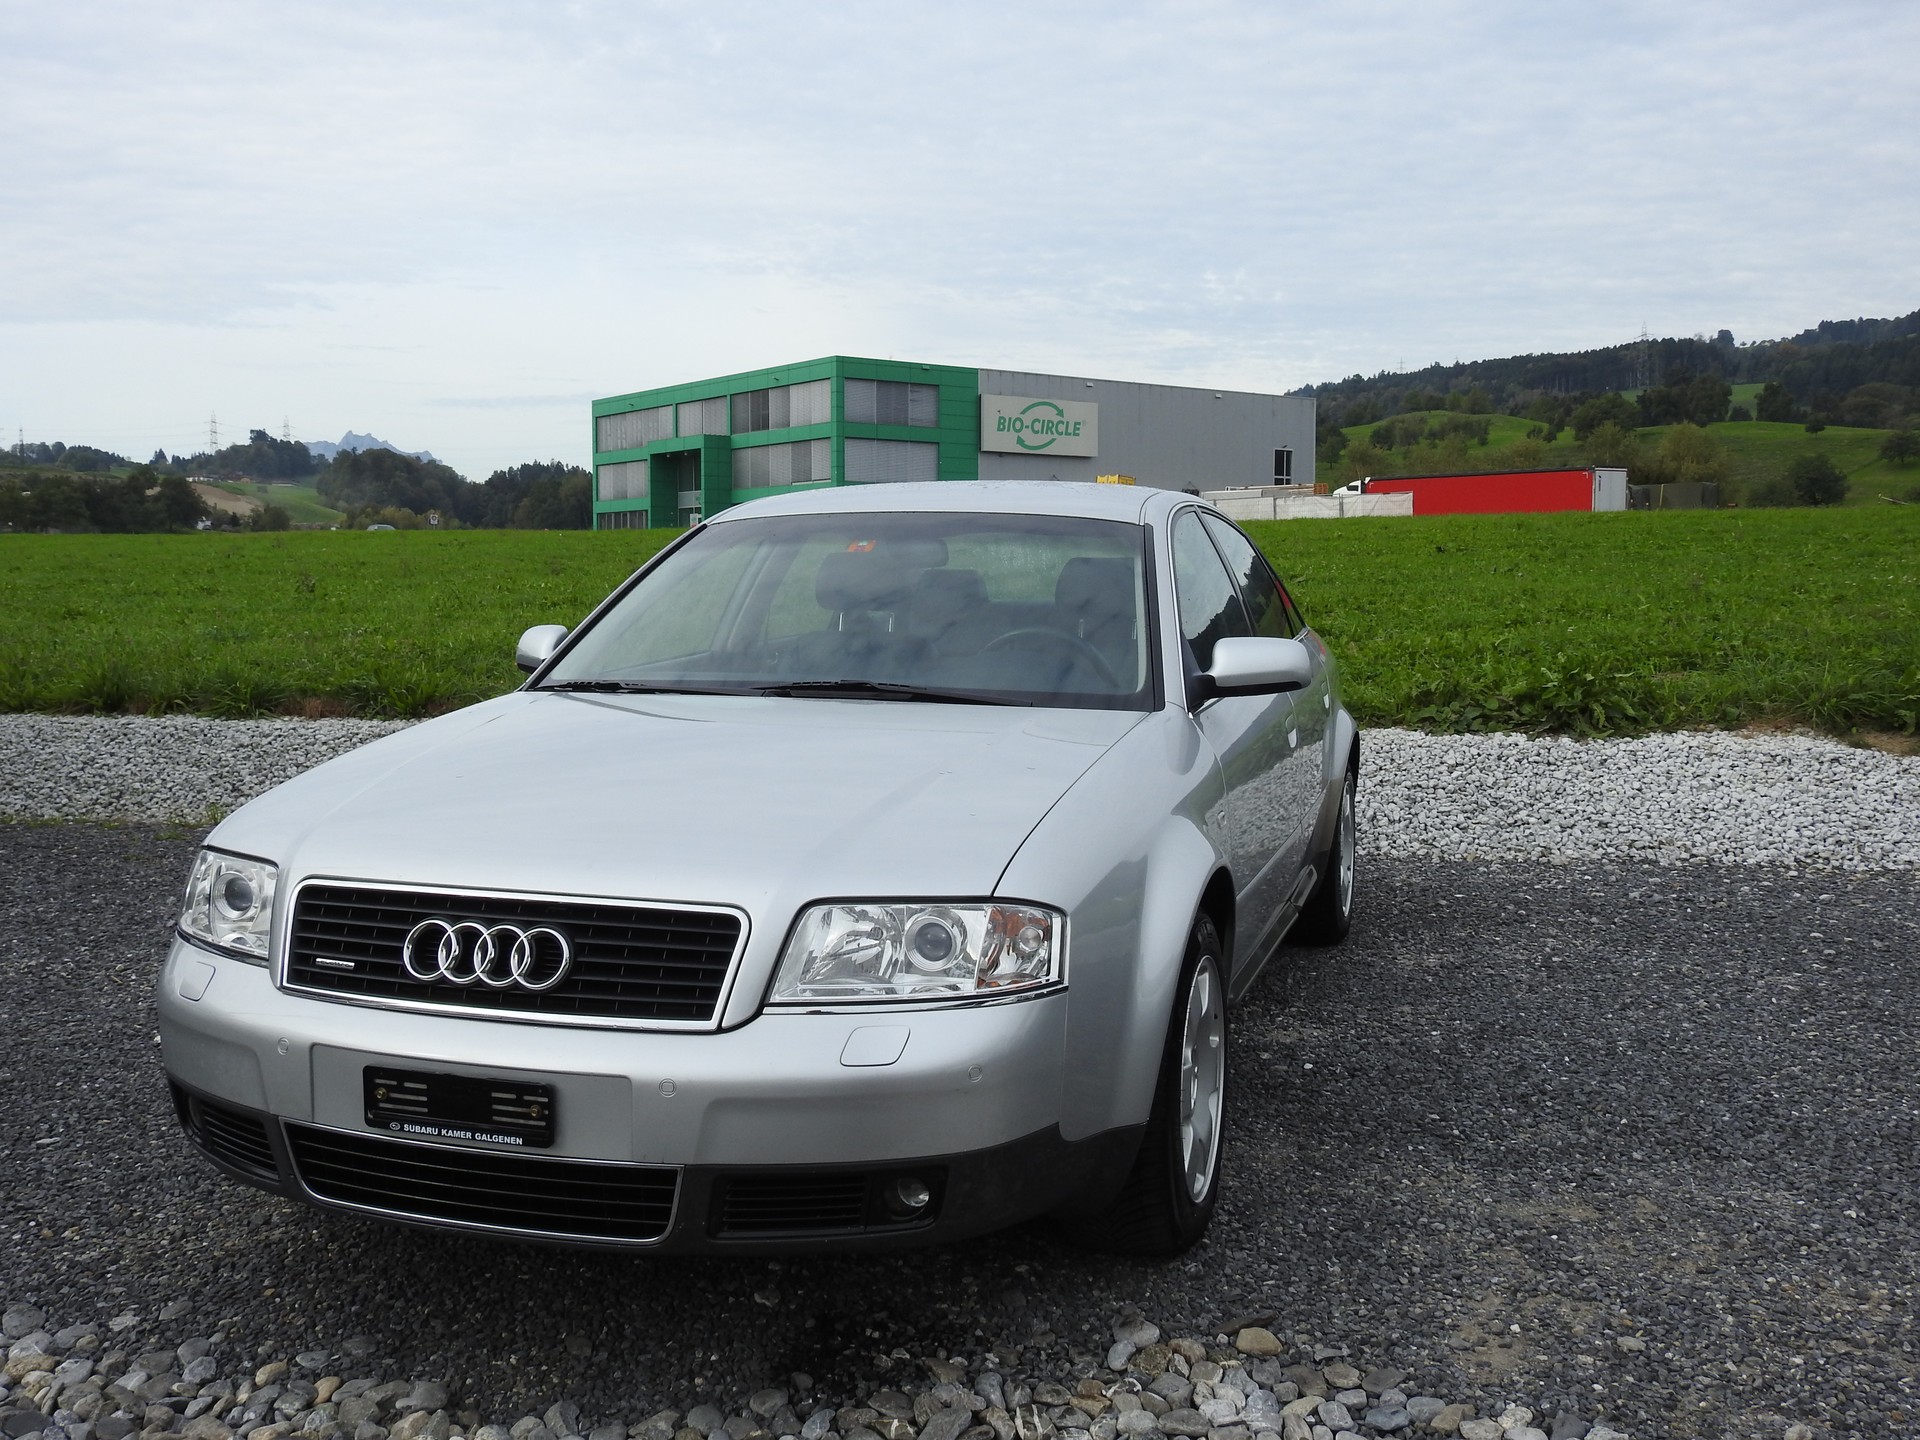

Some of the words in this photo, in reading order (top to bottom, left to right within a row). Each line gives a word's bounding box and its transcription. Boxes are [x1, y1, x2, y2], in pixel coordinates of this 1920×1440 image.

[997, 416, 1082, 437] BIO-CIRCLE
[403, 1124, 438, 1135] SUBARU
[441, 1128, 472, 1140] KAMER
[475, 1133, 523, 1145] GALGENEN
